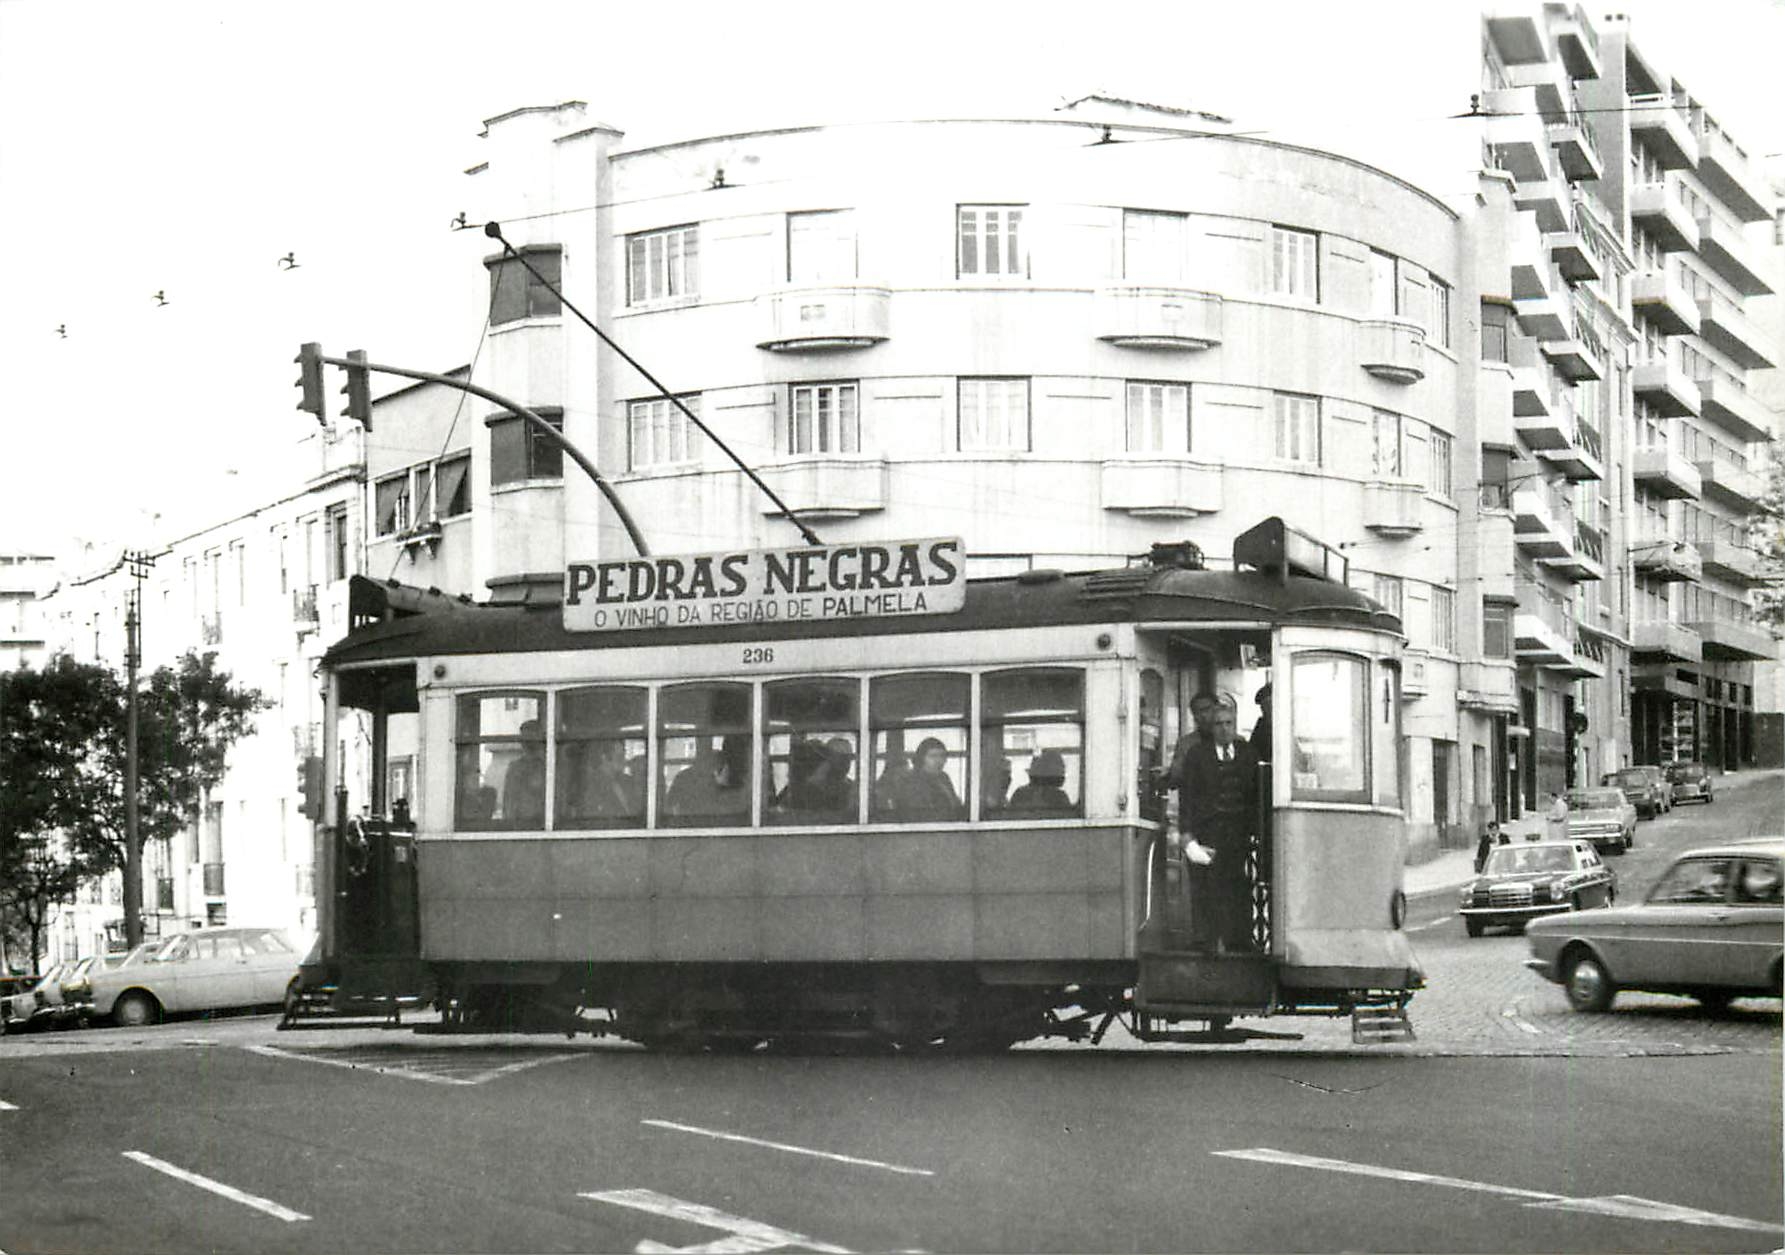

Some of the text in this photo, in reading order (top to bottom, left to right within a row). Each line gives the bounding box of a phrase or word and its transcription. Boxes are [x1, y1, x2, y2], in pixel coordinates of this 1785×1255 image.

[566, 542, 958, 606] PEDRAS NEGRAS
[594, 592, 928, 628] O VINHO DA REGIÃO DE PALMELA
[742, 647, 775, 664] 236
